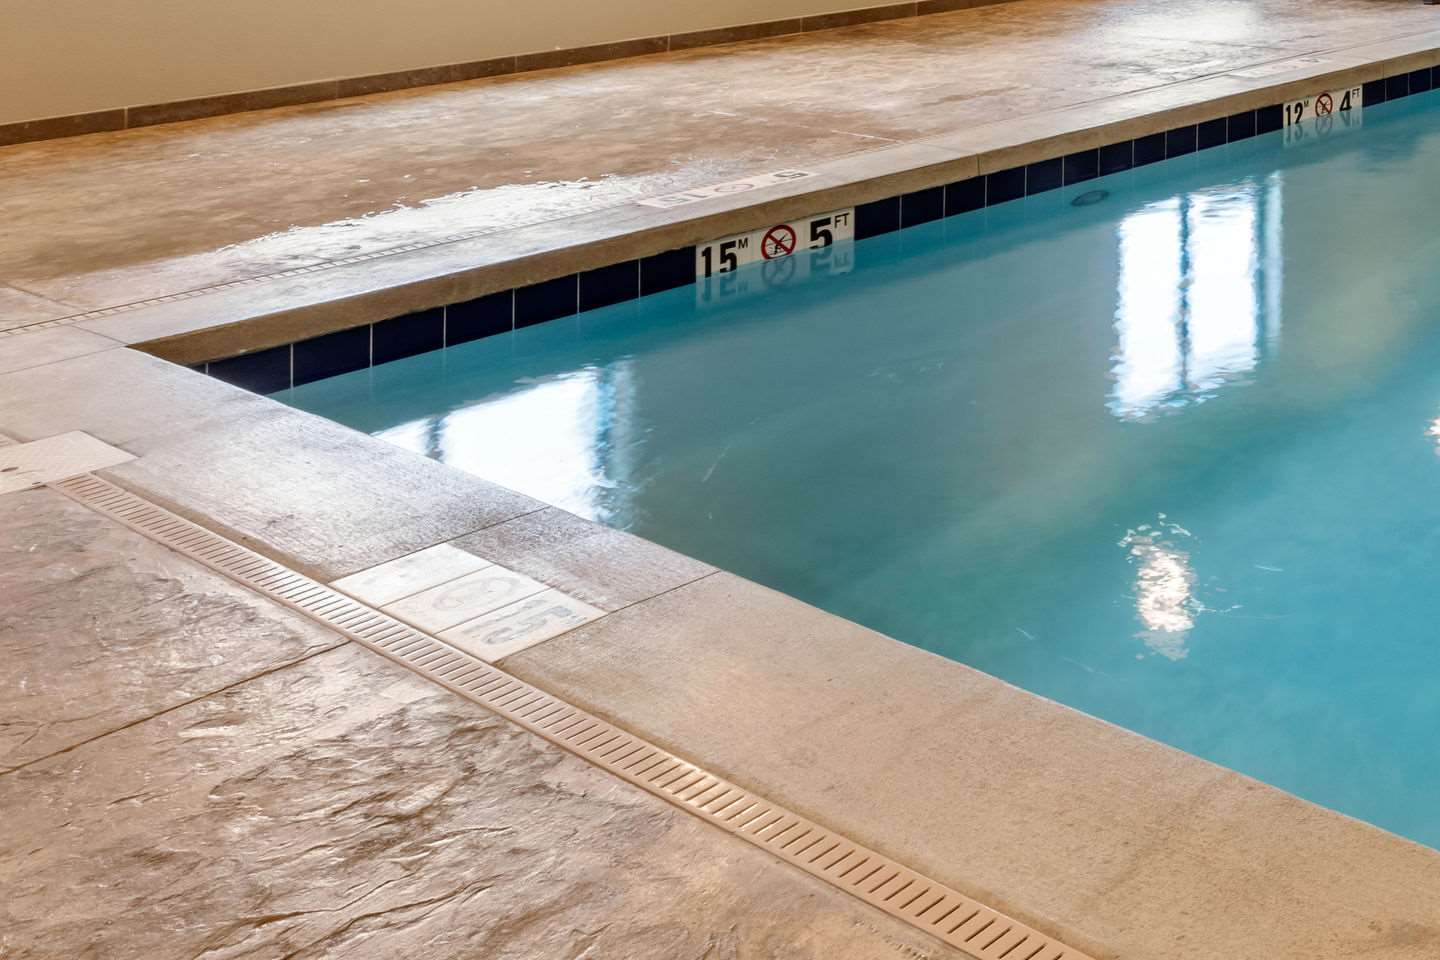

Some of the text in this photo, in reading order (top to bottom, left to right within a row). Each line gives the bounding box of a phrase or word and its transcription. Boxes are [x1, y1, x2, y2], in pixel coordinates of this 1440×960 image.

[1285, 102, 1303, 126] 12
[1340, 88, 1360, 112] 4 FT
[809, 212, 850, 250] 5 FT
[702, 237, 749, 278] 15 M
